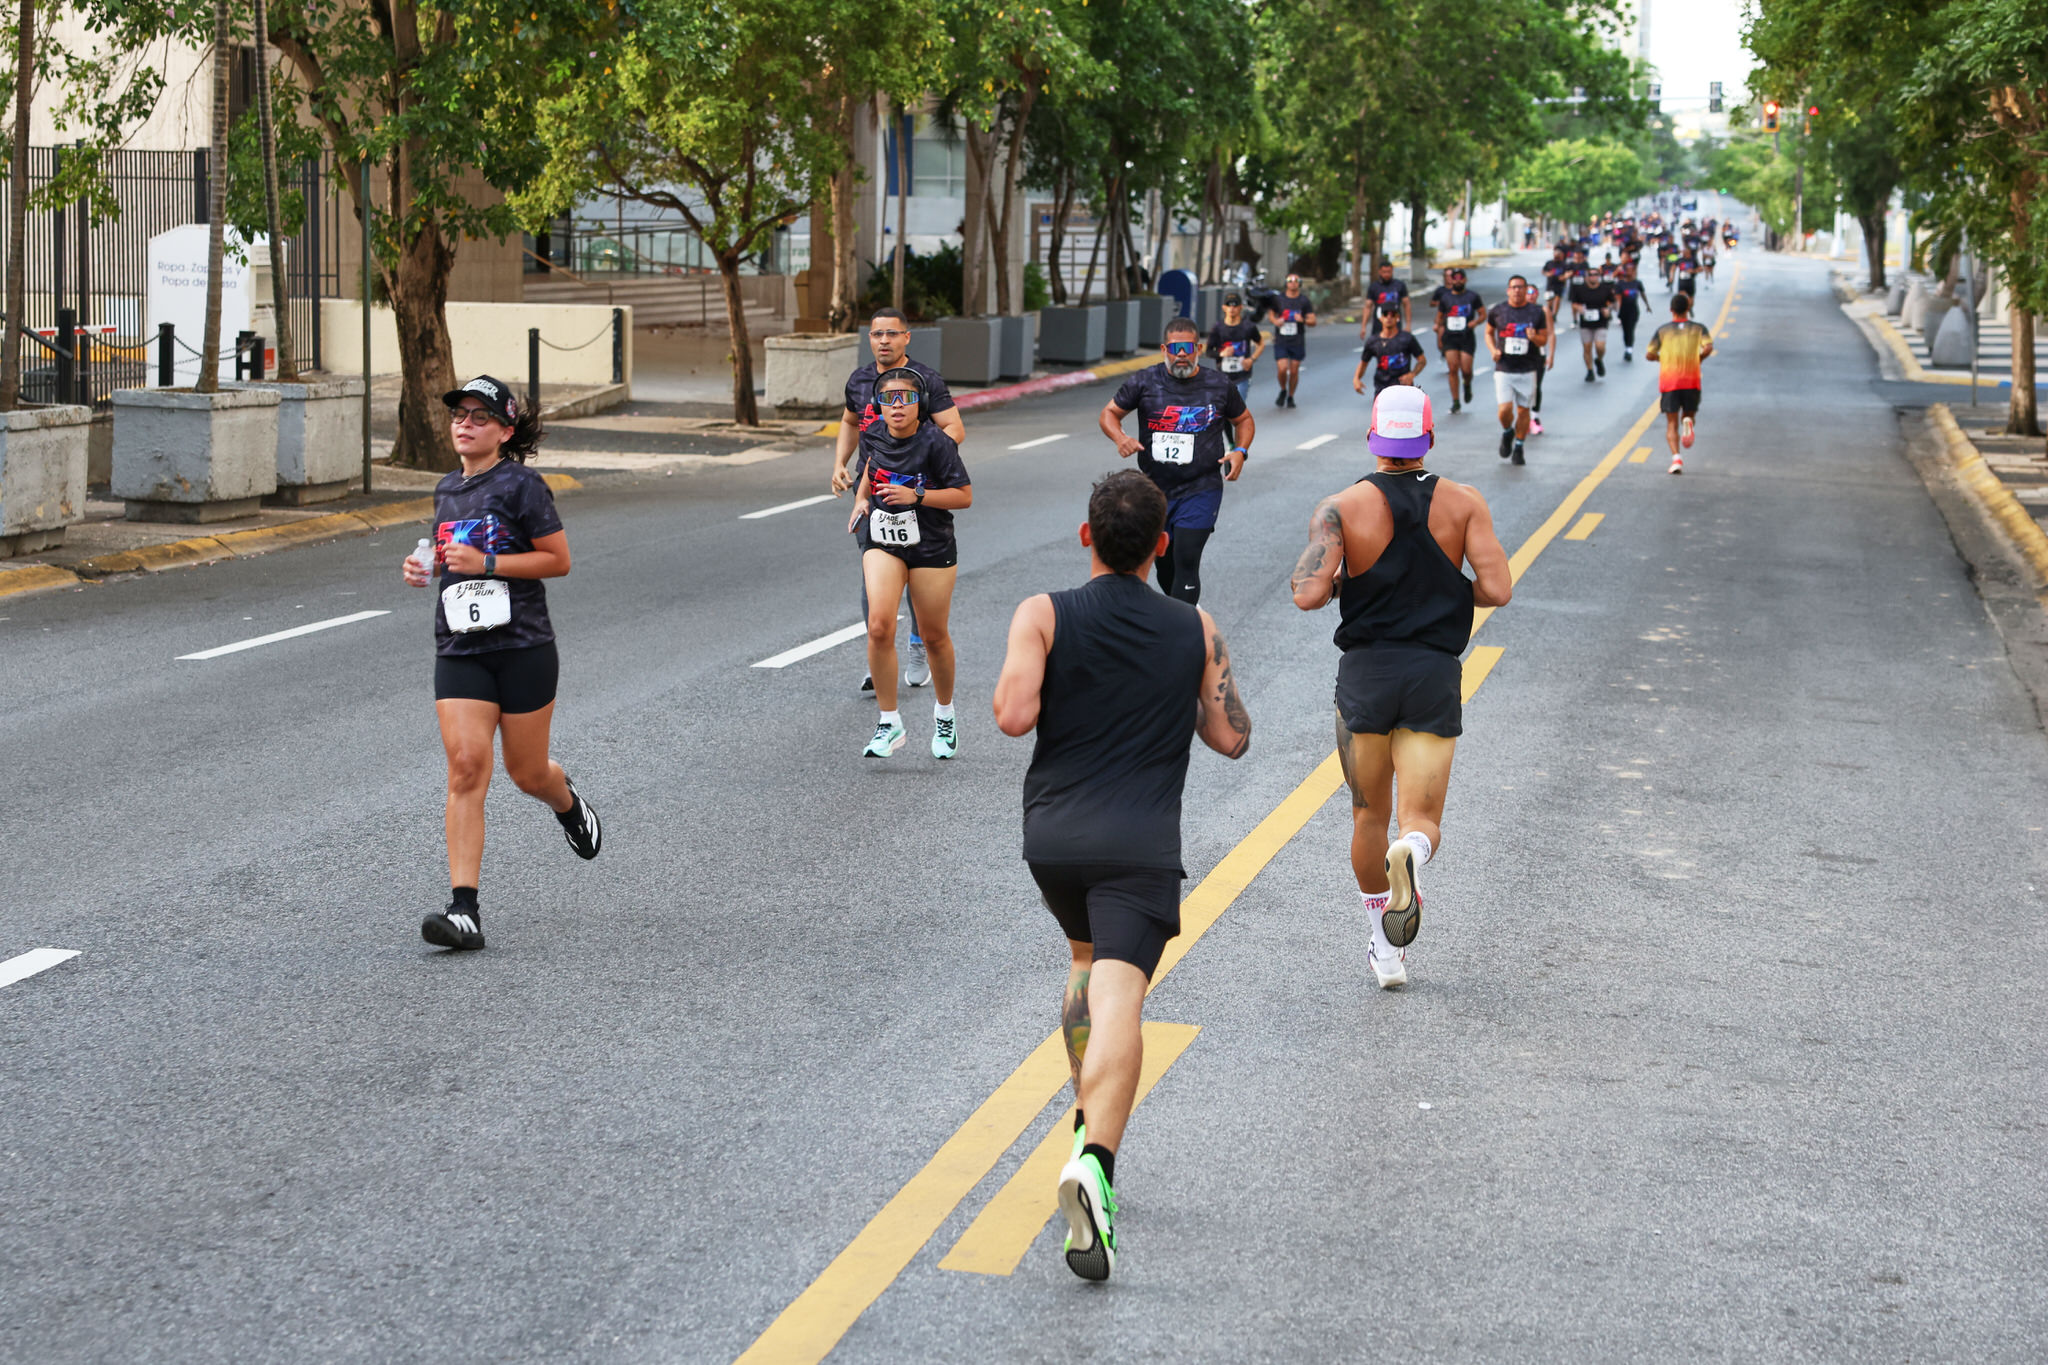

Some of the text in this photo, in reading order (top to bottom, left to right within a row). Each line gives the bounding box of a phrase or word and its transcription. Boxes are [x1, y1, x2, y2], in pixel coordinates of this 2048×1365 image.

[192, 278, 207, 287] de
[1160, 405, 1206, 426] 5K
[1165, 447, 1180, 459] 12
[875, 468, 915, 486] 5K
[438, 519, 482, 546] 5K
[880, 527, 908, 542] 116
[469, 603, 480, 622] 6
